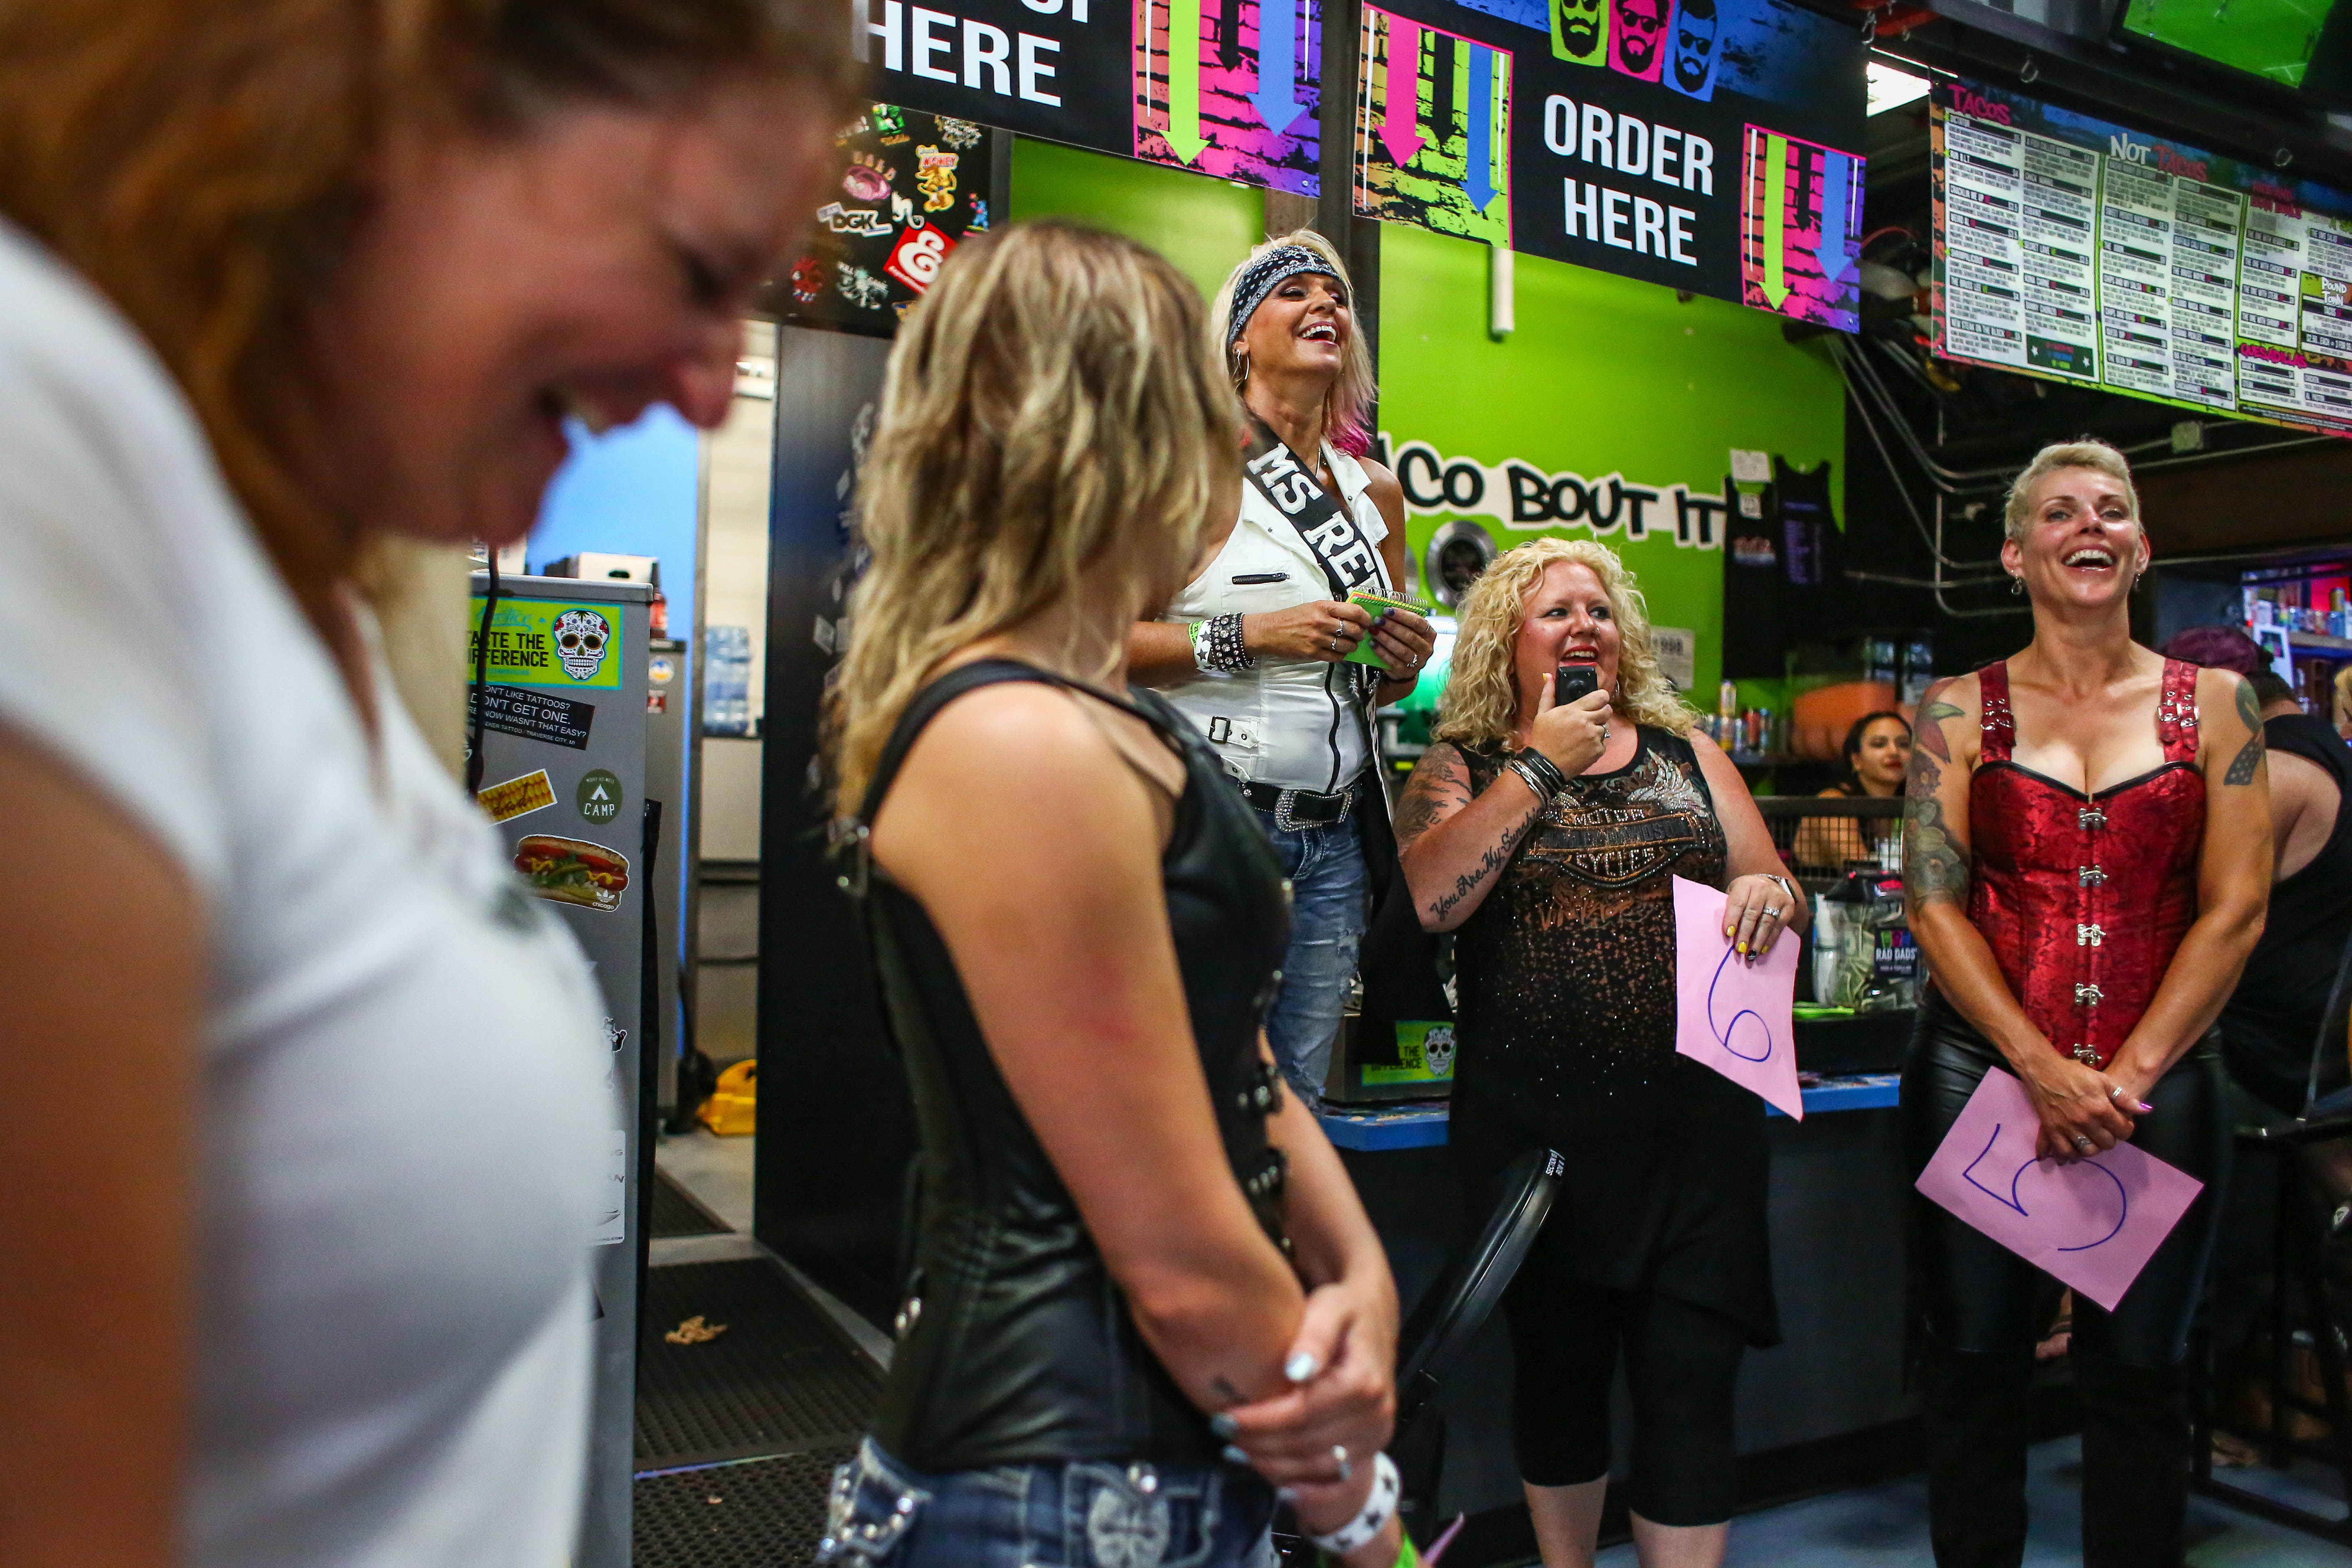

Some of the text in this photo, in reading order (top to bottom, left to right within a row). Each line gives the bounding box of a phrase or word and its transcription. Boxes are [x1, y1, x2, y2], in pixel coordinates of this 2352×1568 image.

[852, 0, 1062, 107] HERE
[1947, 84, 2011, 125] TACOS
[1544, 94, 1714, 196] ORDER
[2111, 133, 2151, 165] NOT
[1564, 177, 1698, 267] HERE
[2241, 343, 2307, 369] QUESADILLAS
[1247, 443, 1323, 514] MS
[1508, 466, 1657, 535] BOUT
[1675, 490, 1726, 543] IT
[516, 633, 545, 650] THE
[485, 686, 570, 710] ON'T LIKE TATTOOS?
[513, 703, 539, 717] GET
[542, 709, 570, 724] ONE.
[501, 725, 522, 733] TATTOO
[526, 731, 554, 741] TRAVERSE
[506, 714, 537, 727] WASN'T
[538, 722, 559, 732] THAT
[561, 727, 587, 738] EASY?
[584, 803, 615, 816] CAMP
[1430, 893, 1460, 922] You
[1456, 869, 1484, 898] Are
[1482, 846, 1506, 873] My
[592, 902, 614, 910] chicago
[1708, 942, 1772, 1062] 6
[1962, 1123, 2127, 1251] 5
